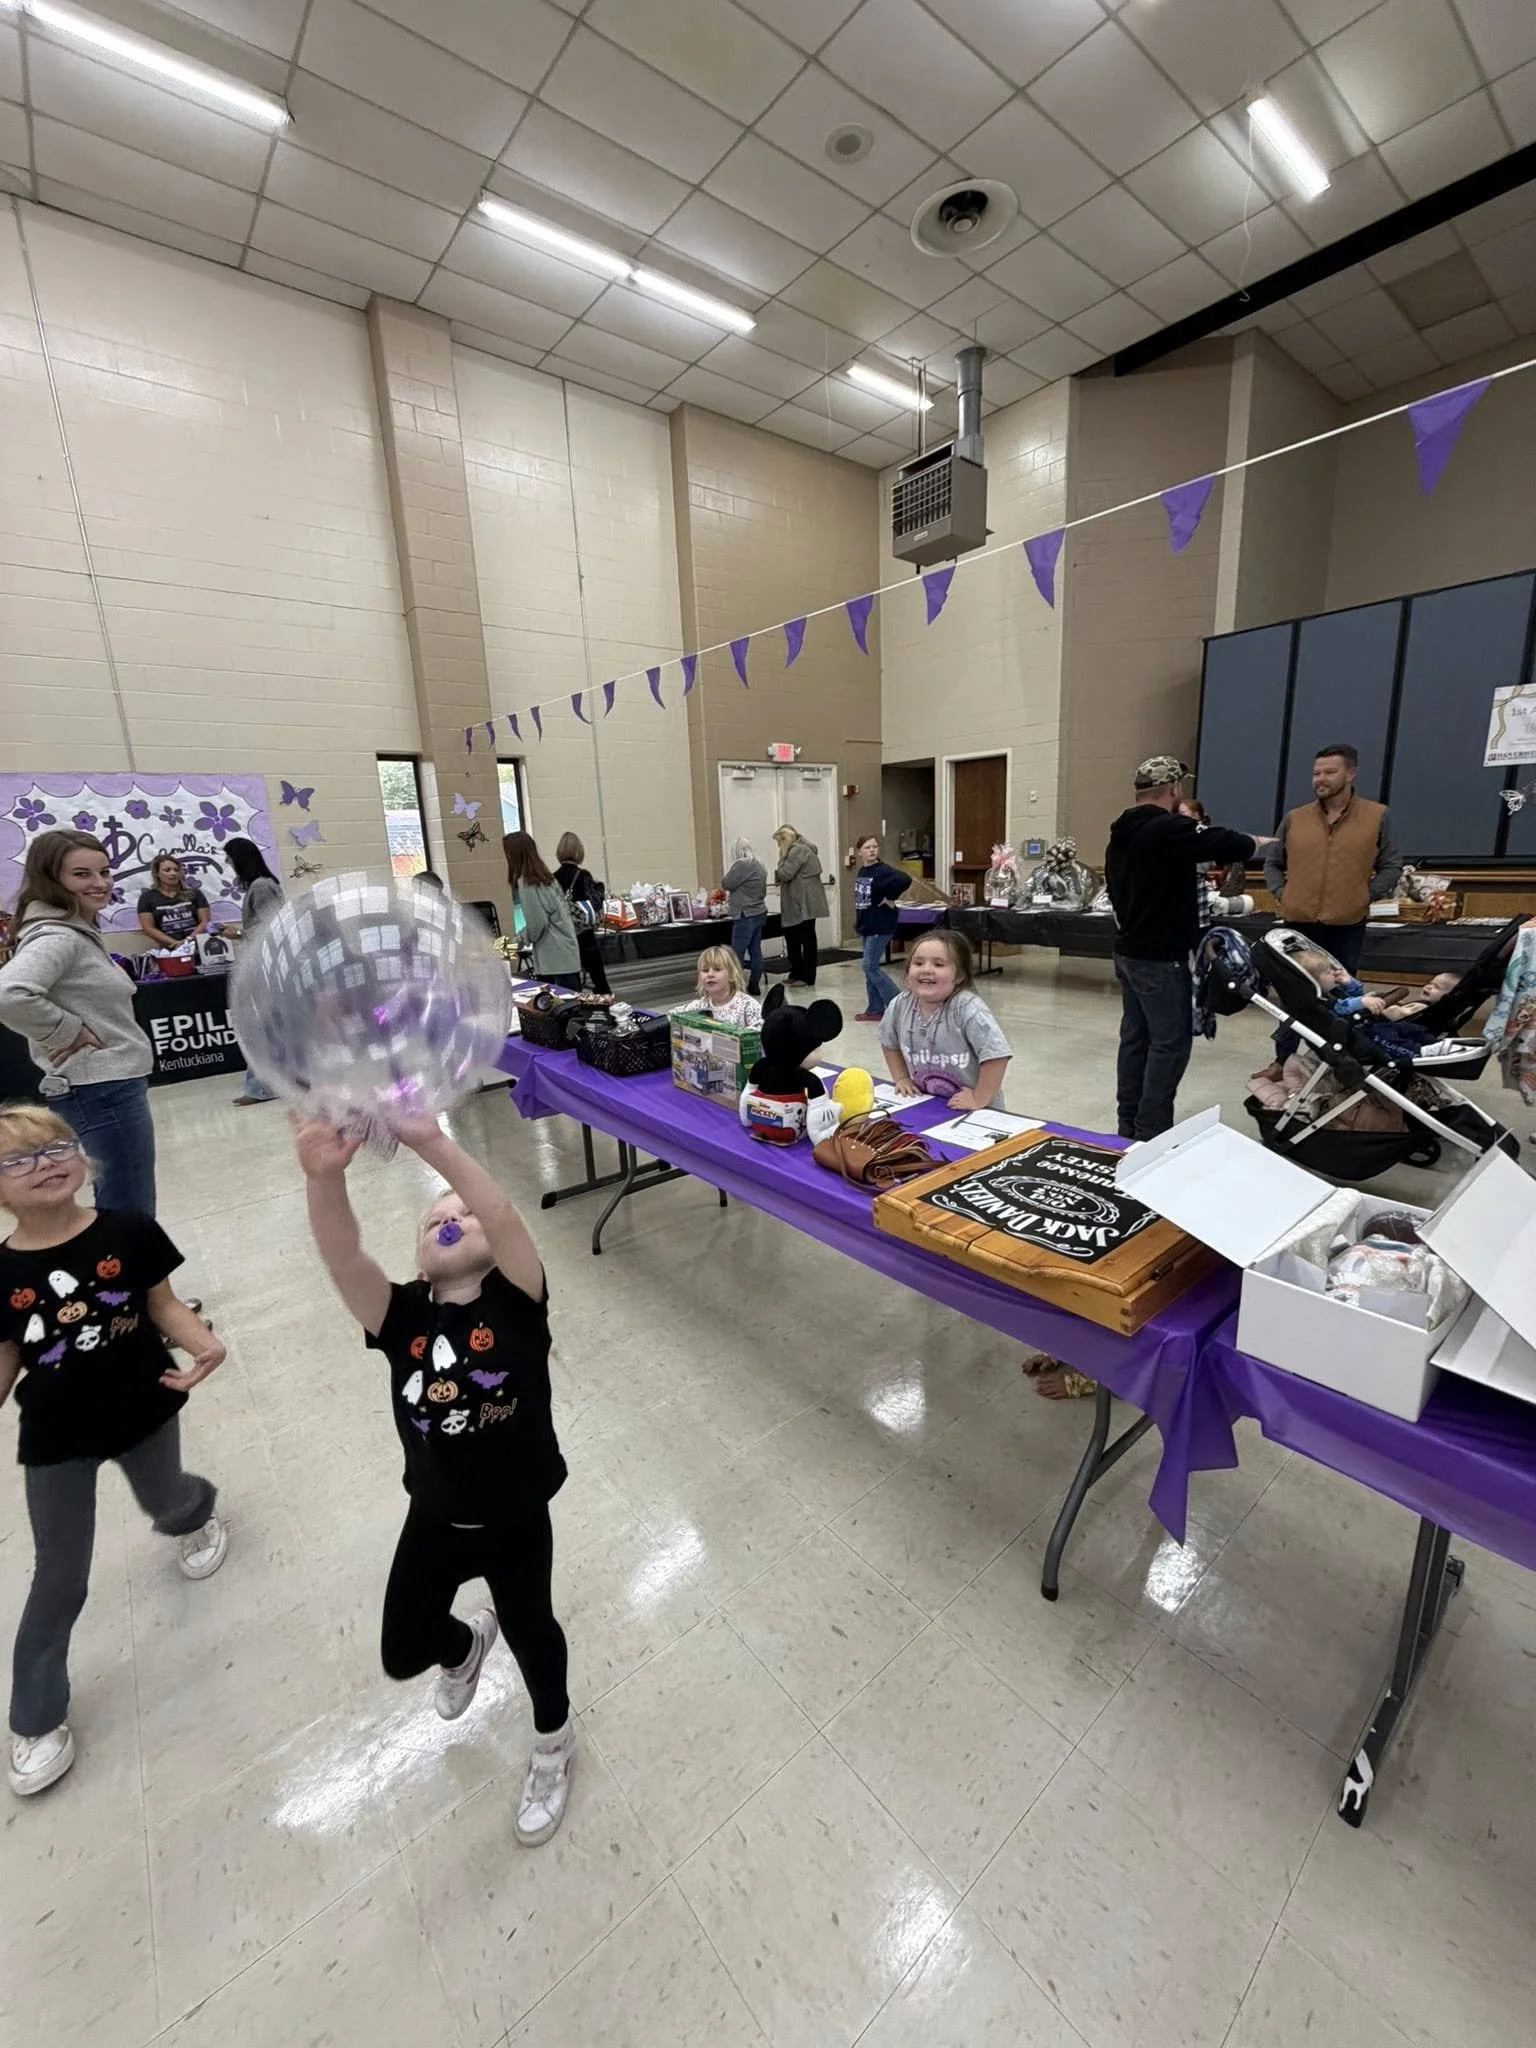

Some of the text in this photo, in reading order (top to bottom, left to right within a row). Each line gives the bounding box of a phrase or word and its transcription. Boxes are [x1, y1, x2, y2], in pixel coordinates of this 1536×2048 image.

[160, 1052, 225, 1072] Kentuckiana
[1029, 1192, 1067, 1208] Old
[1043, 1185, 1084, 1200] BRAND
[1036, 1218, 1120, 1247] JACK
[479, 1398, 518, 1429] Boo!
